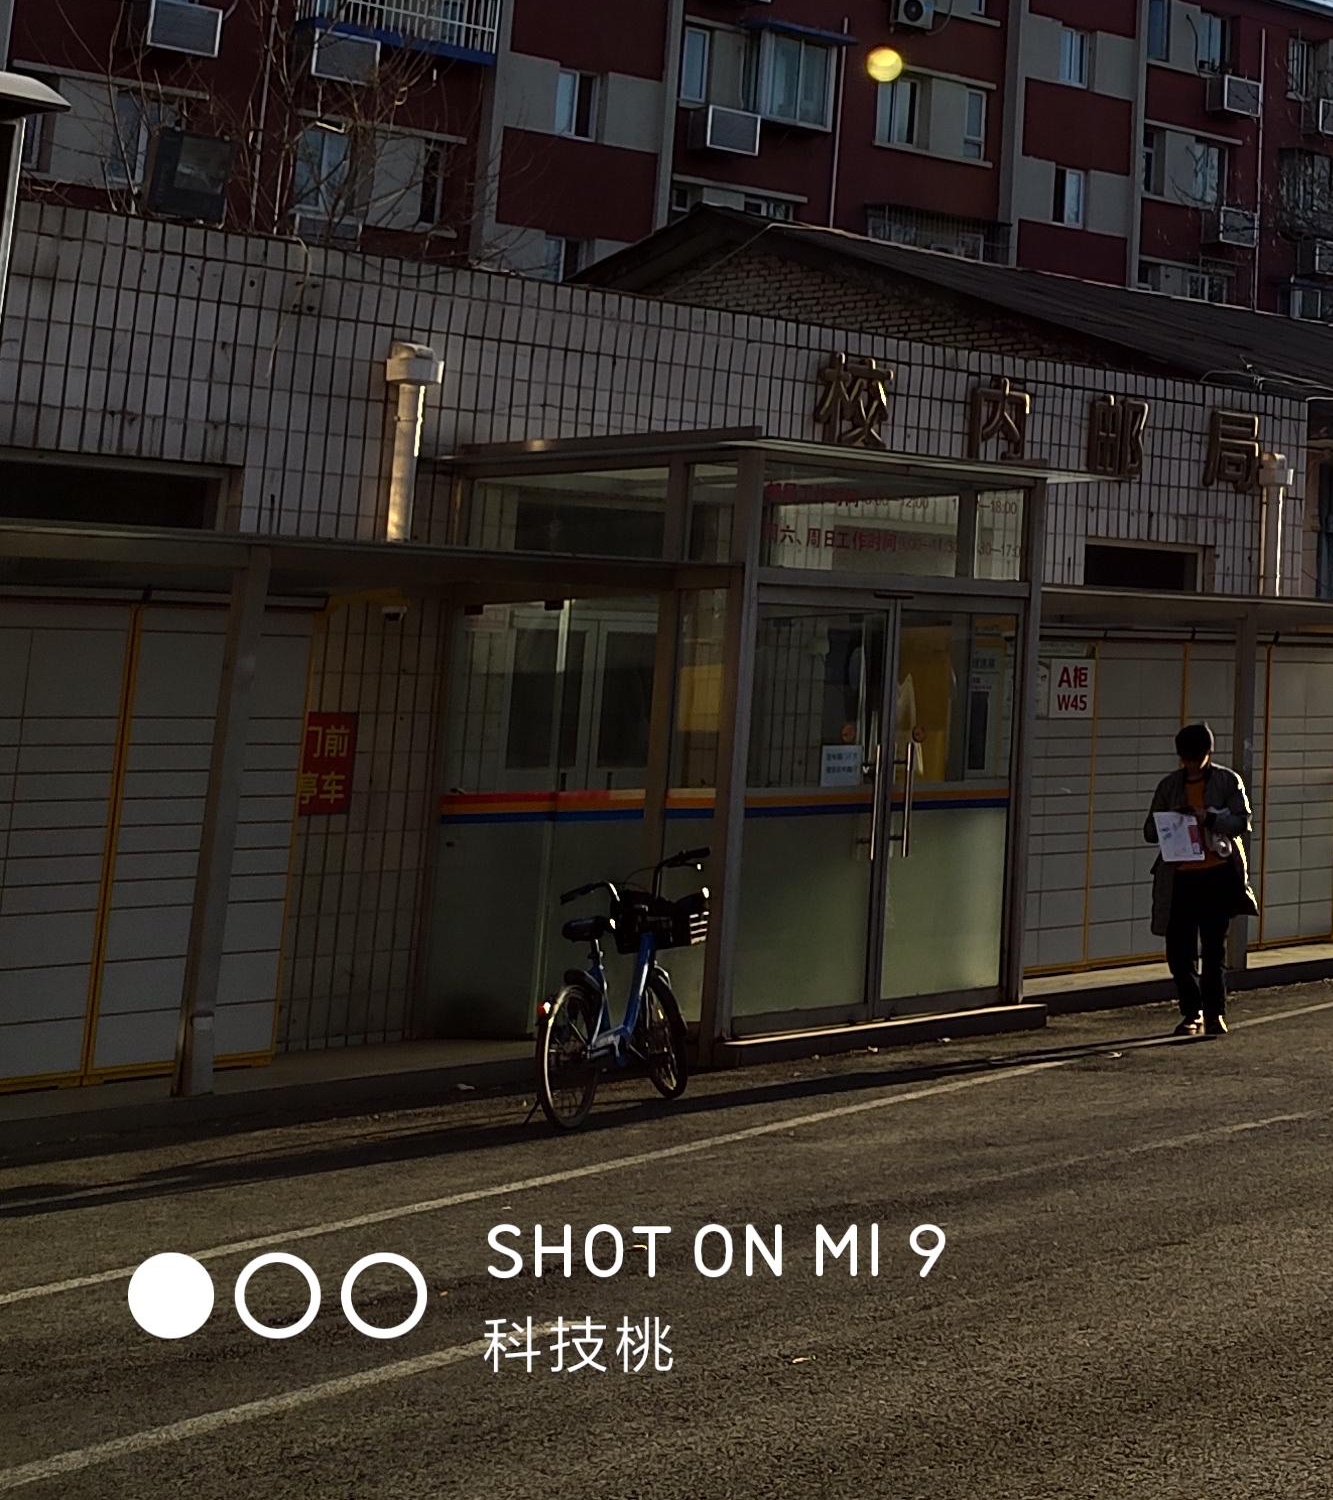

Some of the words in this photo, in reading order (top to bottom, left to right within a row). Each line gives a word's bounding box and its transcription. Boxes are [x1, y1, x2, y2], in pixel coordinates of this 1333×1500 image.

[815, 351, 1262, 492] 校内邮局
[1058, 665, 1088, 689] A柜
[1057, 694, 1087, 712] W45
